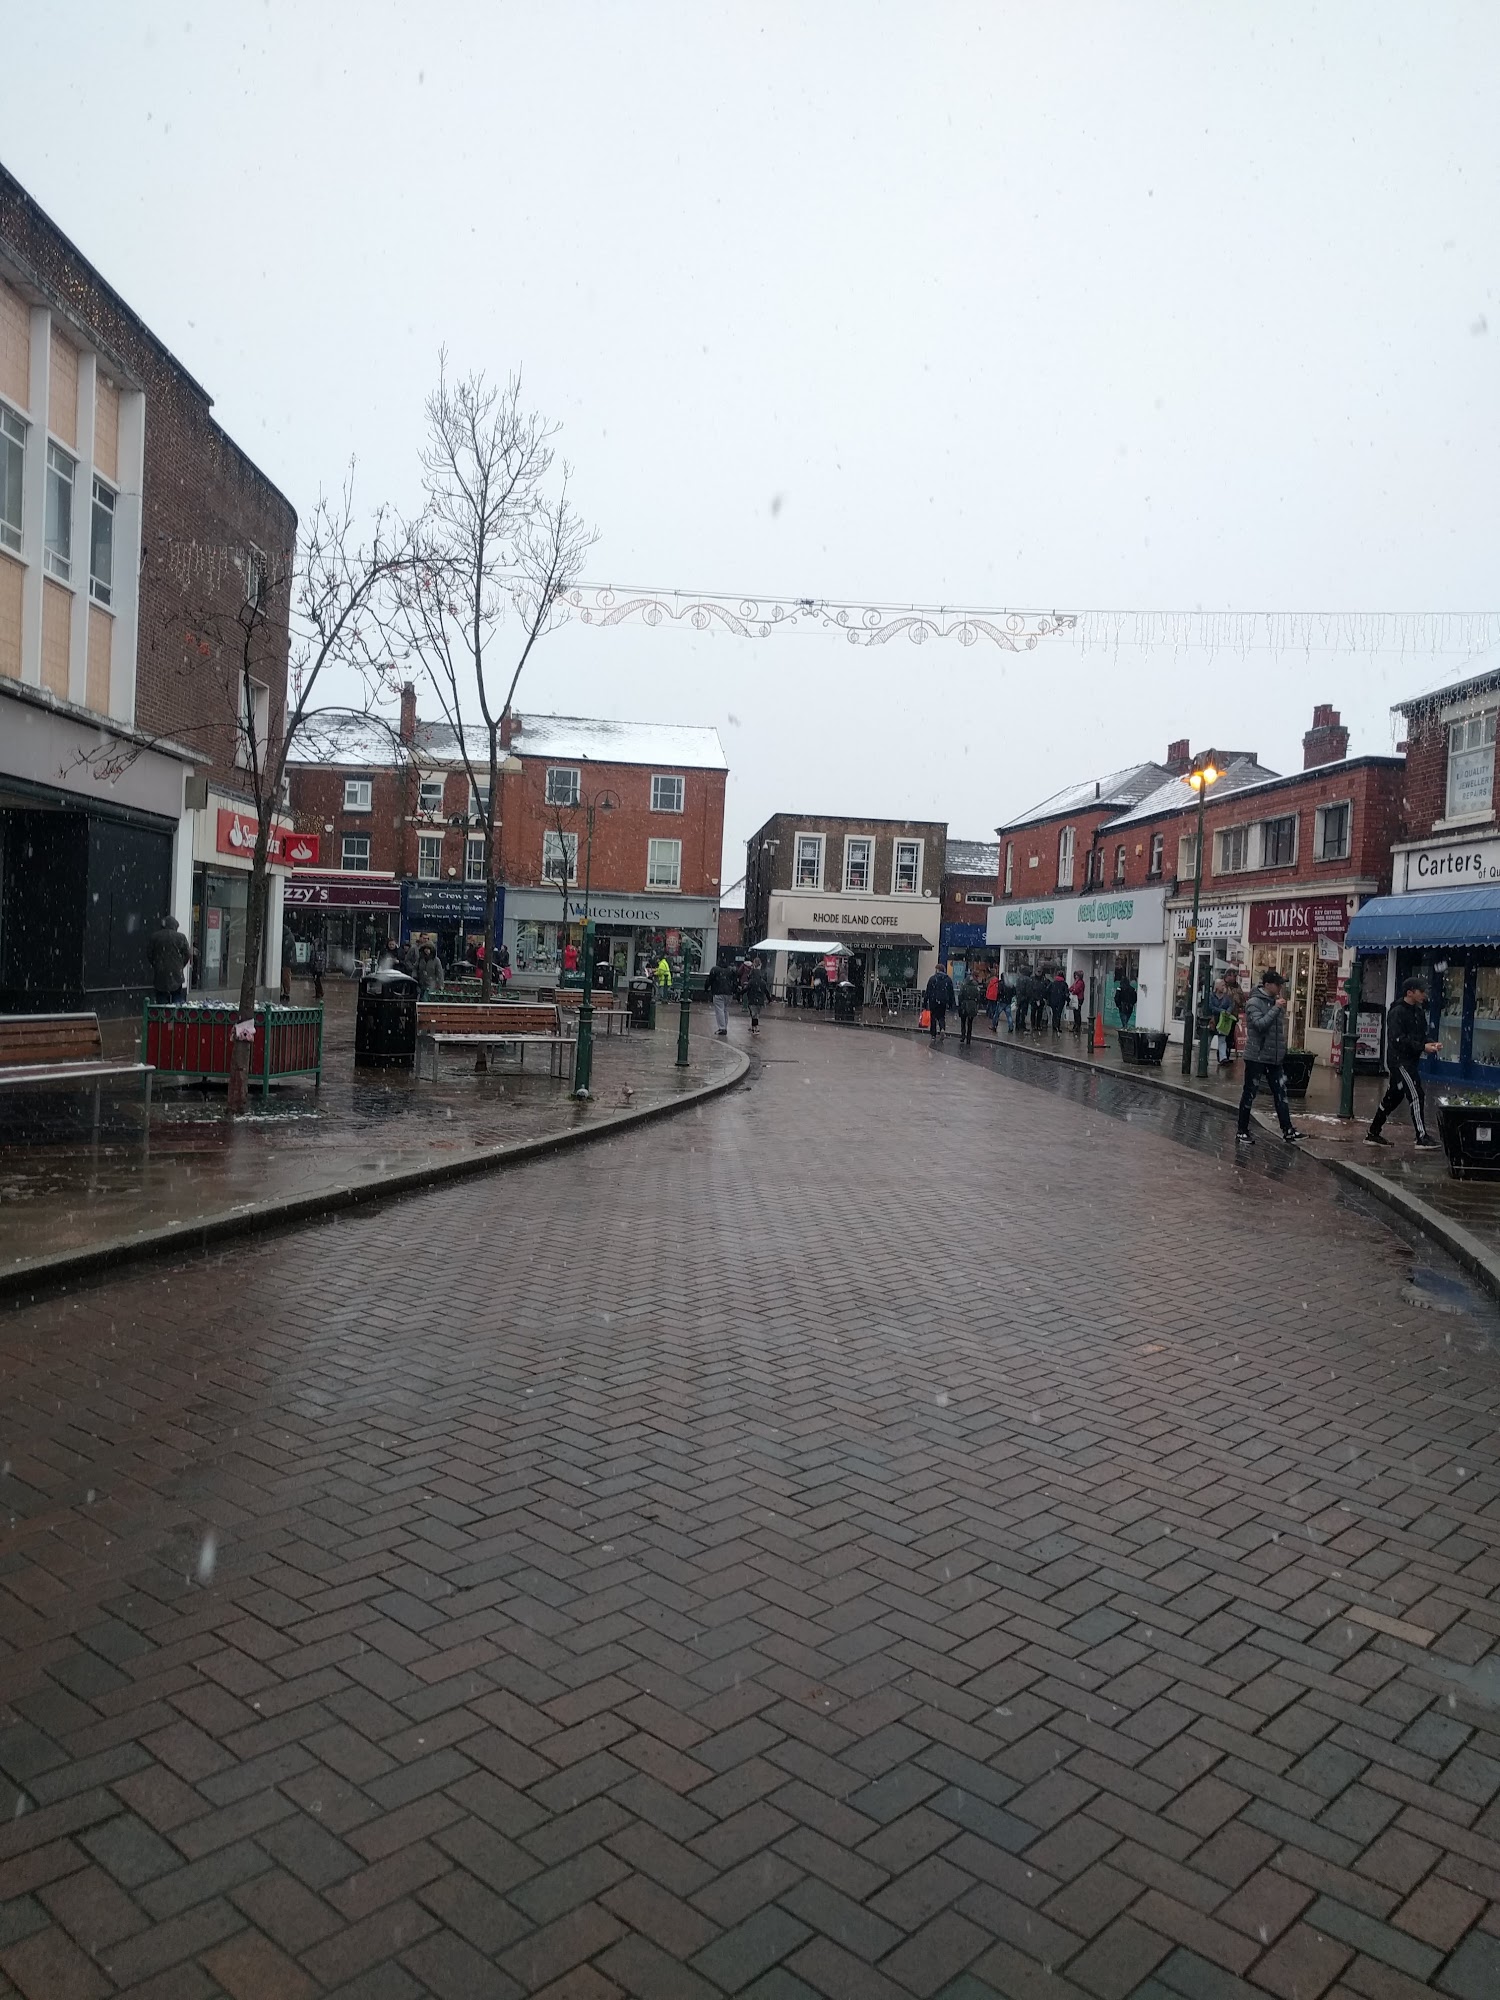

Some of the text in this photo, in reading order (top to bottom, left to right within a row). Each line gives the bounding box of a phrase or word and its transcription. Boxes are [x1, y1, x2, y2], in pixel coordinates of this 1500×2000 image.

[1464, 765, 1490, 778] QUALITY
[1458, 776, 1493, 790] JEWELLERY
[1462, 790, 1487, 800] REPAIRS
[1418, 853, 1482, 876] Carters
[1478, 867, 1486, 879] of
[569, 902, 660, 920] Waterstones
[1097, 900, 1134, 927] express
[813, 912, 898, 926] RHODE ISLAND COFFEE
[1023, 908, 1054, 930] express
[1229, 920, 1237, 928] shop
